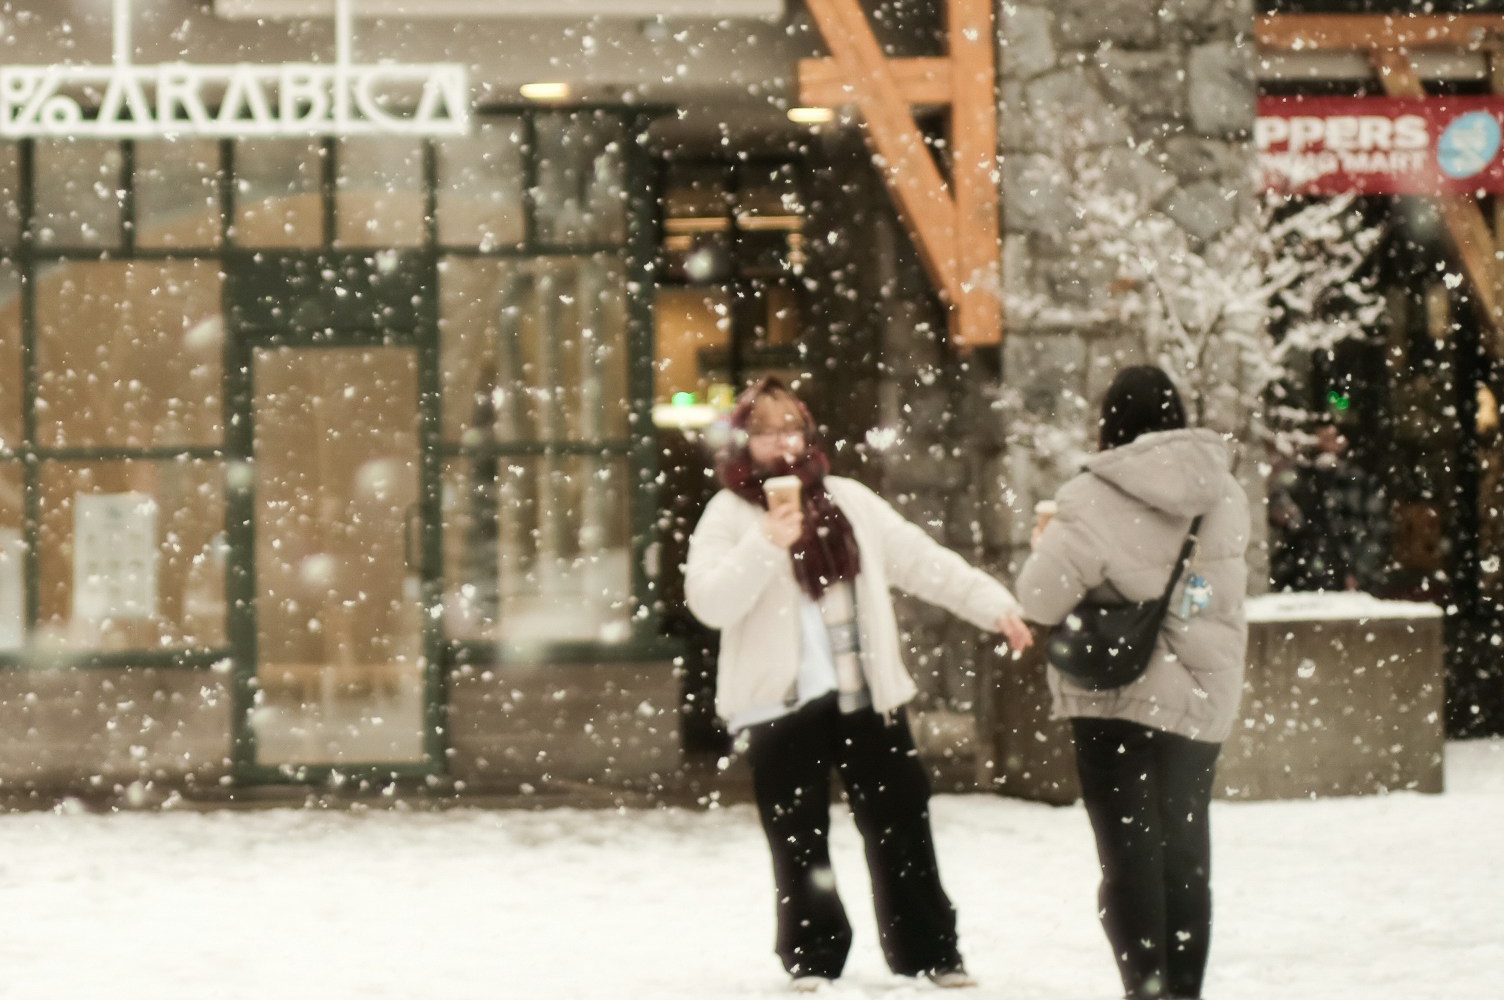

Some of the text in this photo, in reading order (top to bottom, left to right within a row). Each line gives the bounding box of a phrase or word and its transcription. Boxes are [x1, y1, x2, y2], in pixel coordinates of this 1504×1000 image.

[94, 66, 468, 135] ARABICA
[1254, 114, 1430, 151] PPERS
[1343, 152, 1427, 172] MART
